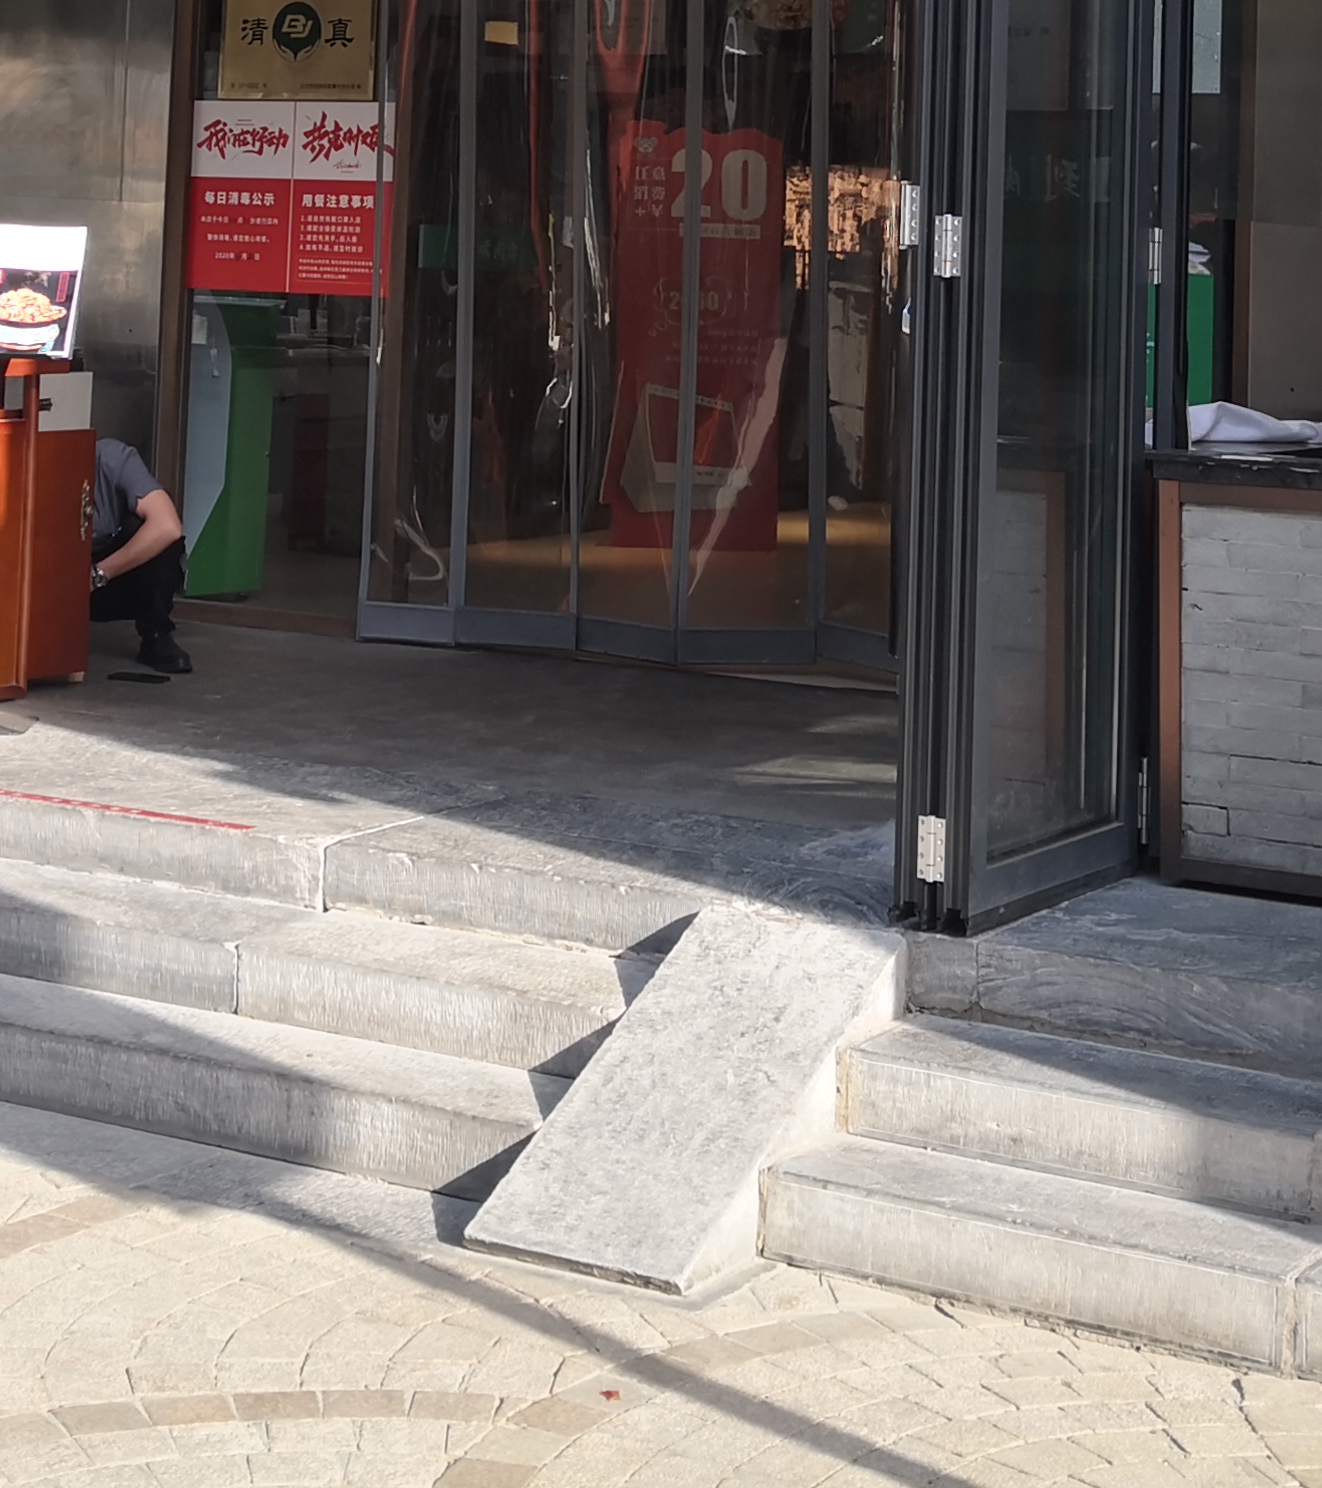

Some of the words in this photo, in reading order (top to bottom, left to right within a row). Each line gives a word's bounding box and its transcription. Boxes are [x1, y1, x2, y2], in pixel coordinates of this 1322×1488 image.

[204, 190, 276, 207] 每日消毒公示
[301, 194, 375, 209] 用餐注意事项
